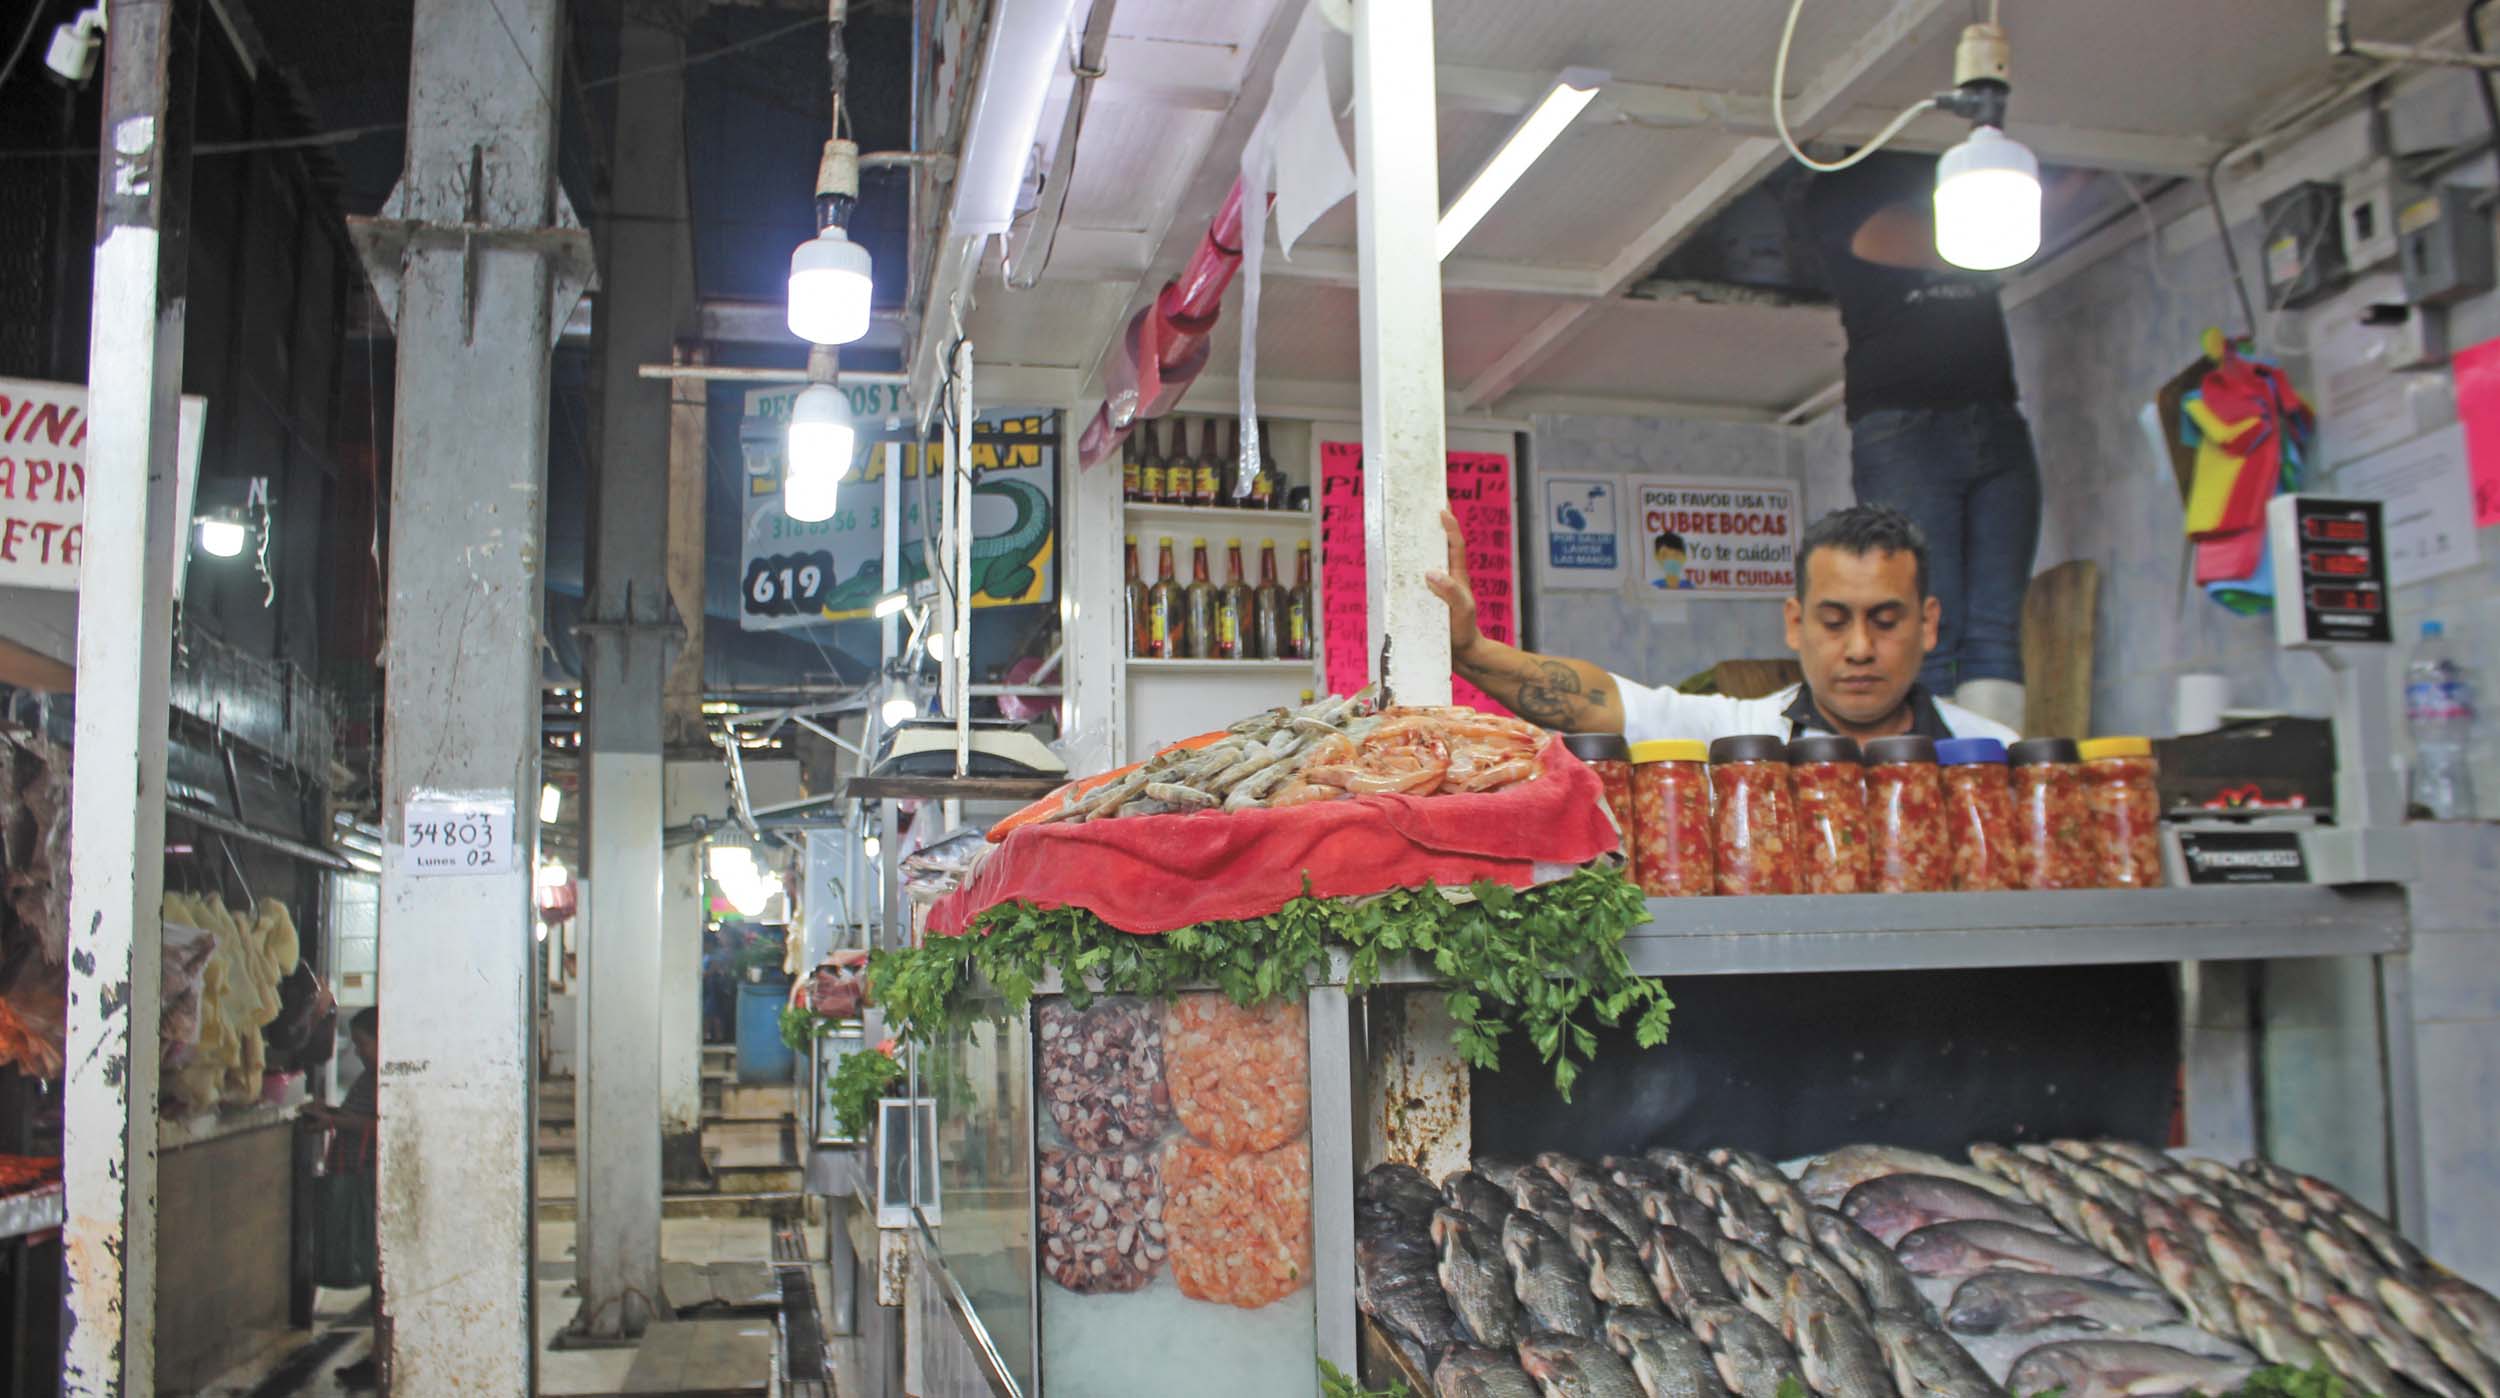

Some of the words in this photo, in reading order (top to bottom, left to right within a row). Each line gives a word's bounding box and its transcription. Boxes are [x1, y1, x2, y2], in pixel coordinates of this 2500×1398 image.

[1646, 493, 1677, 506] POR
[1680, 493, 1730, 508] FAVOR
[1735, 495, 1765, 509] USA
[1767, 496, 1788, 510] TU
[1646, 511, 1787, 537] CUBREBOCAS
[1689, 542, 1713, 561] Yo
[1715, 544, 1731, 561] te
[752, 565, 822, 604] 619
[1684, 568, 1706, 585] TU
[1709, 569, 1732, 585] ME
[1736, 569, 1794, 586] CUIDAS
[407, 821, 493, 849] 34803
[417, 857, 456, 867] Lunes
[466, 849, 496, 867] 02
